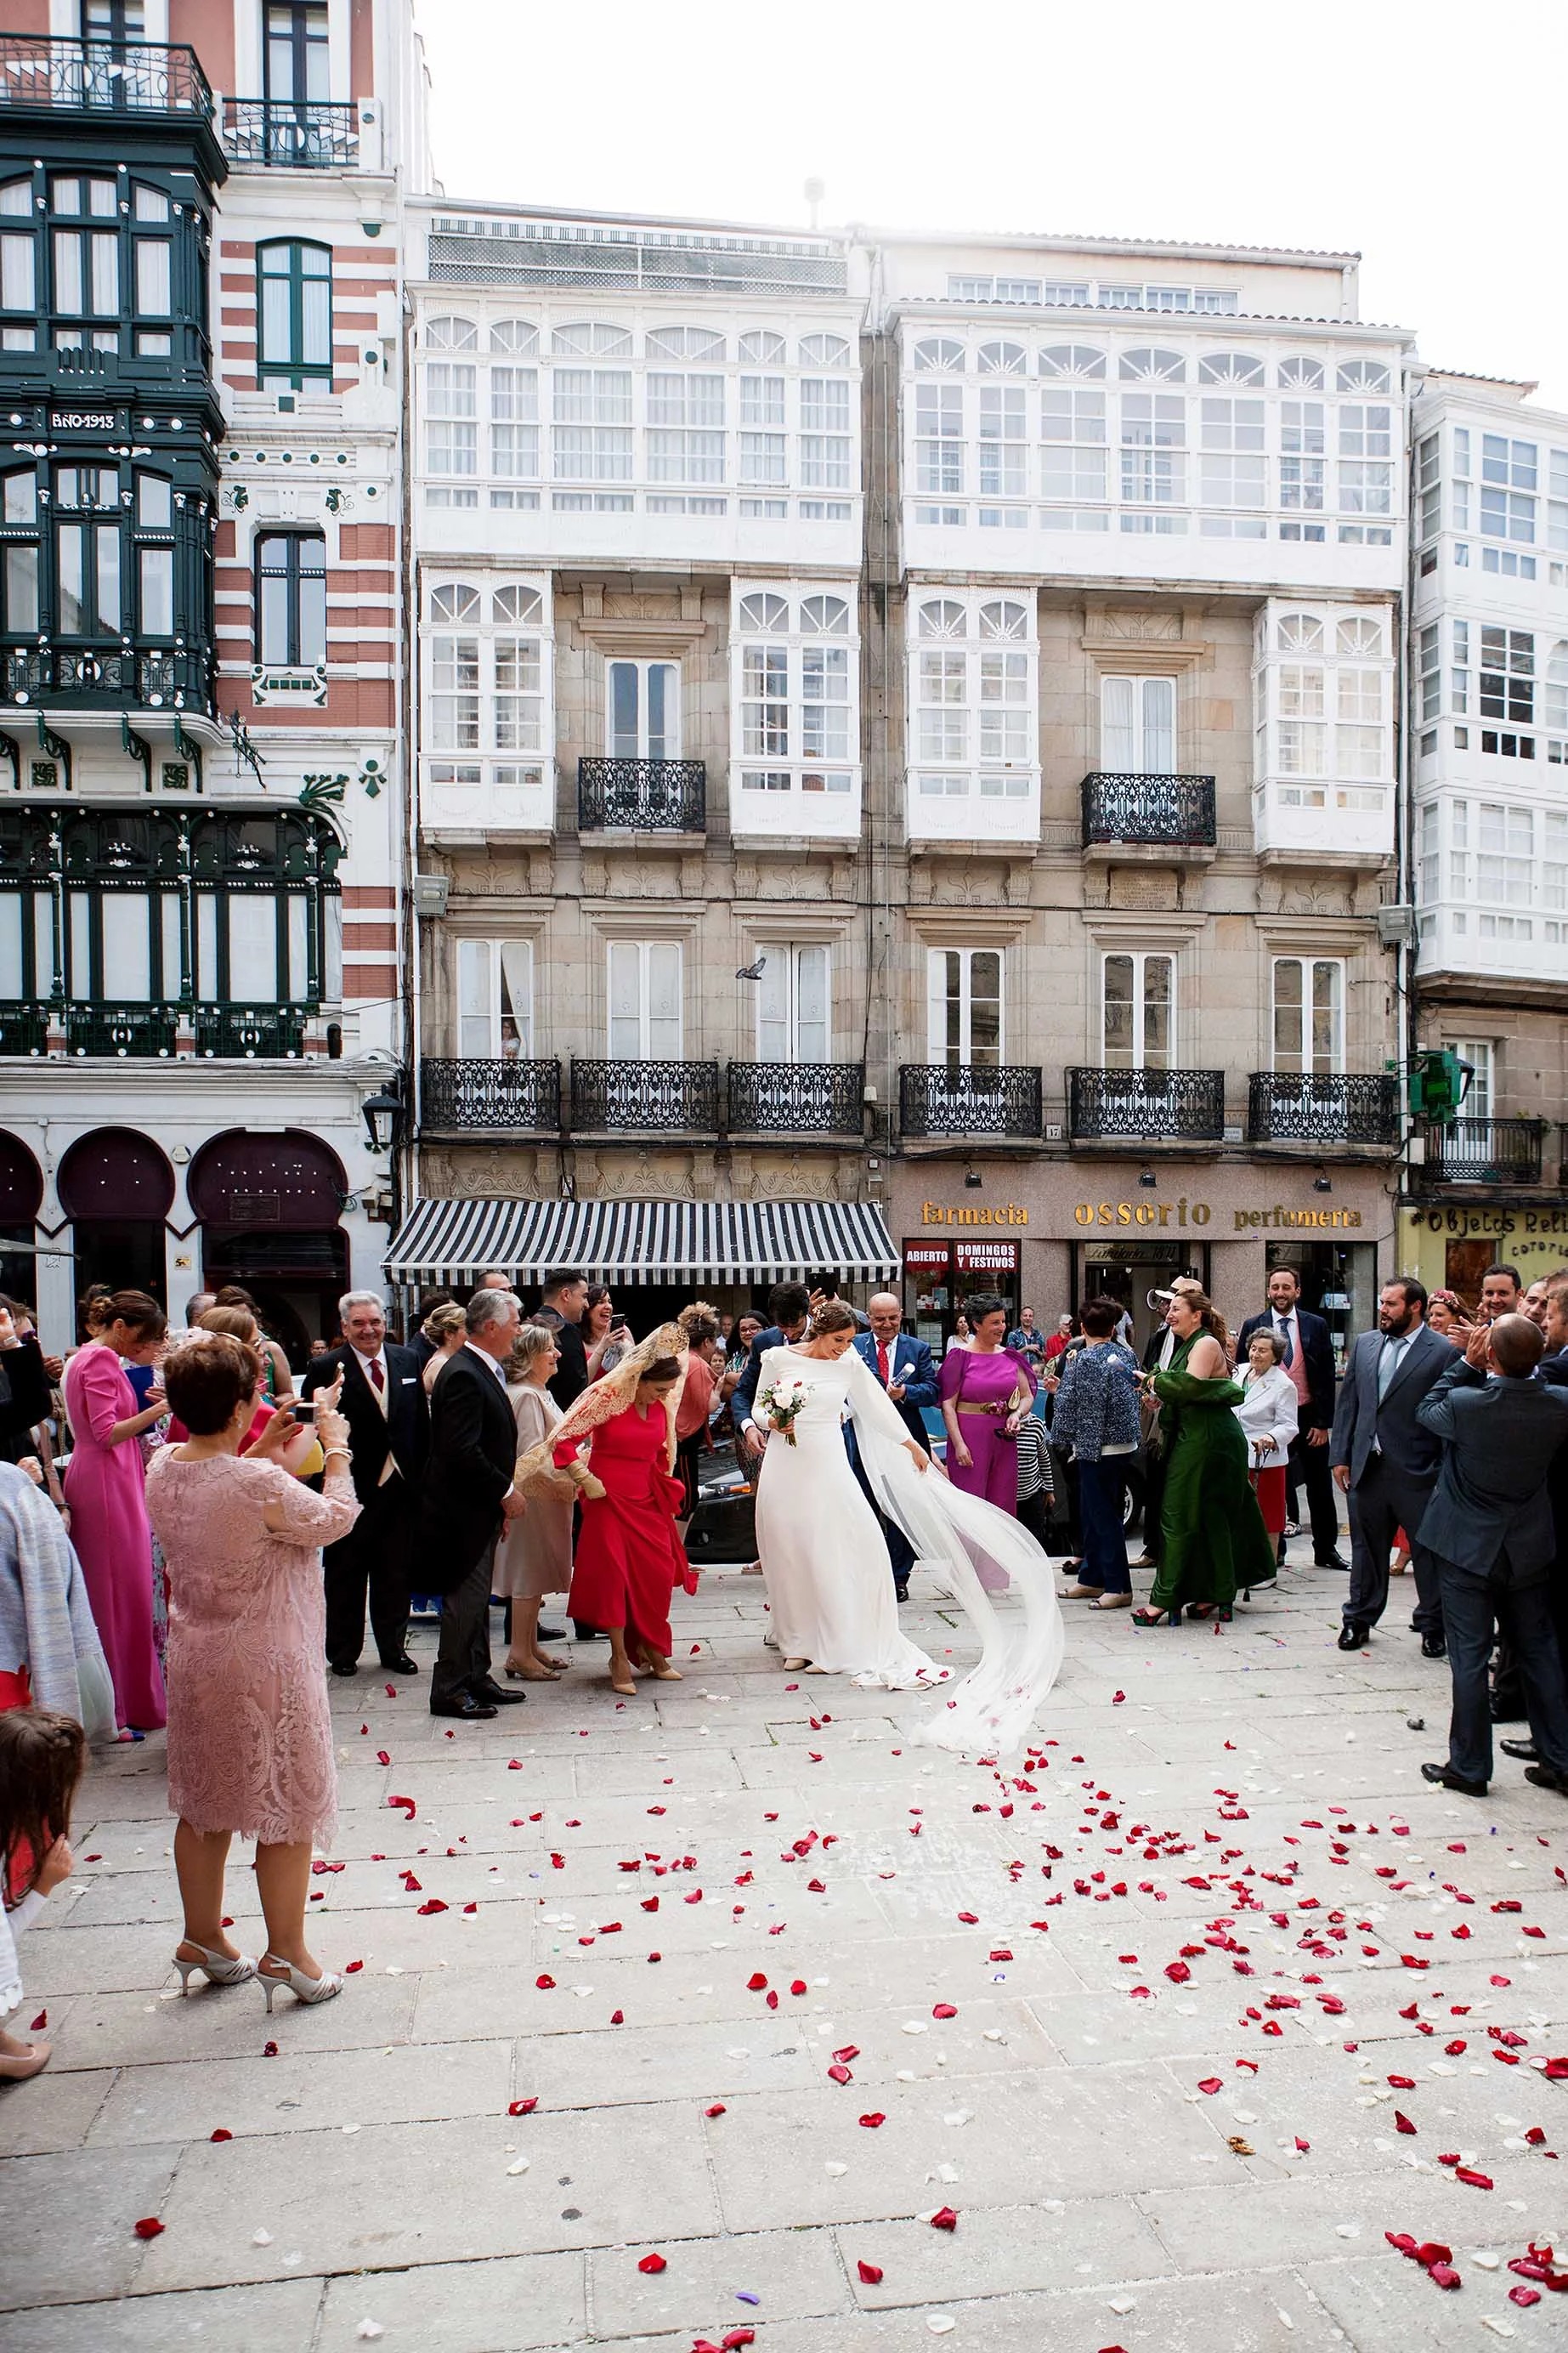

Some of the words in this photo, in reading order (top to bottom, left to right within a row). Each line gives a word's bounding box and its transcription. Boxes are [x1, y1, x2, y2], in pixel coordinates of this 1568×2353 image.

[920, 1201, 1029, 1226] farmacia
[1074, 1197, 1211, 1227] ossorio
[1428, 1207, 1515, 1238] Objetos
[906, 1250, 948, 1262] ABIERTO
[957, 1245, 1015, 1256] DOMINGOS
[957, 1257, 965, 1268] Y
[969, 1257, 1015, 1268] FESTIVOS
